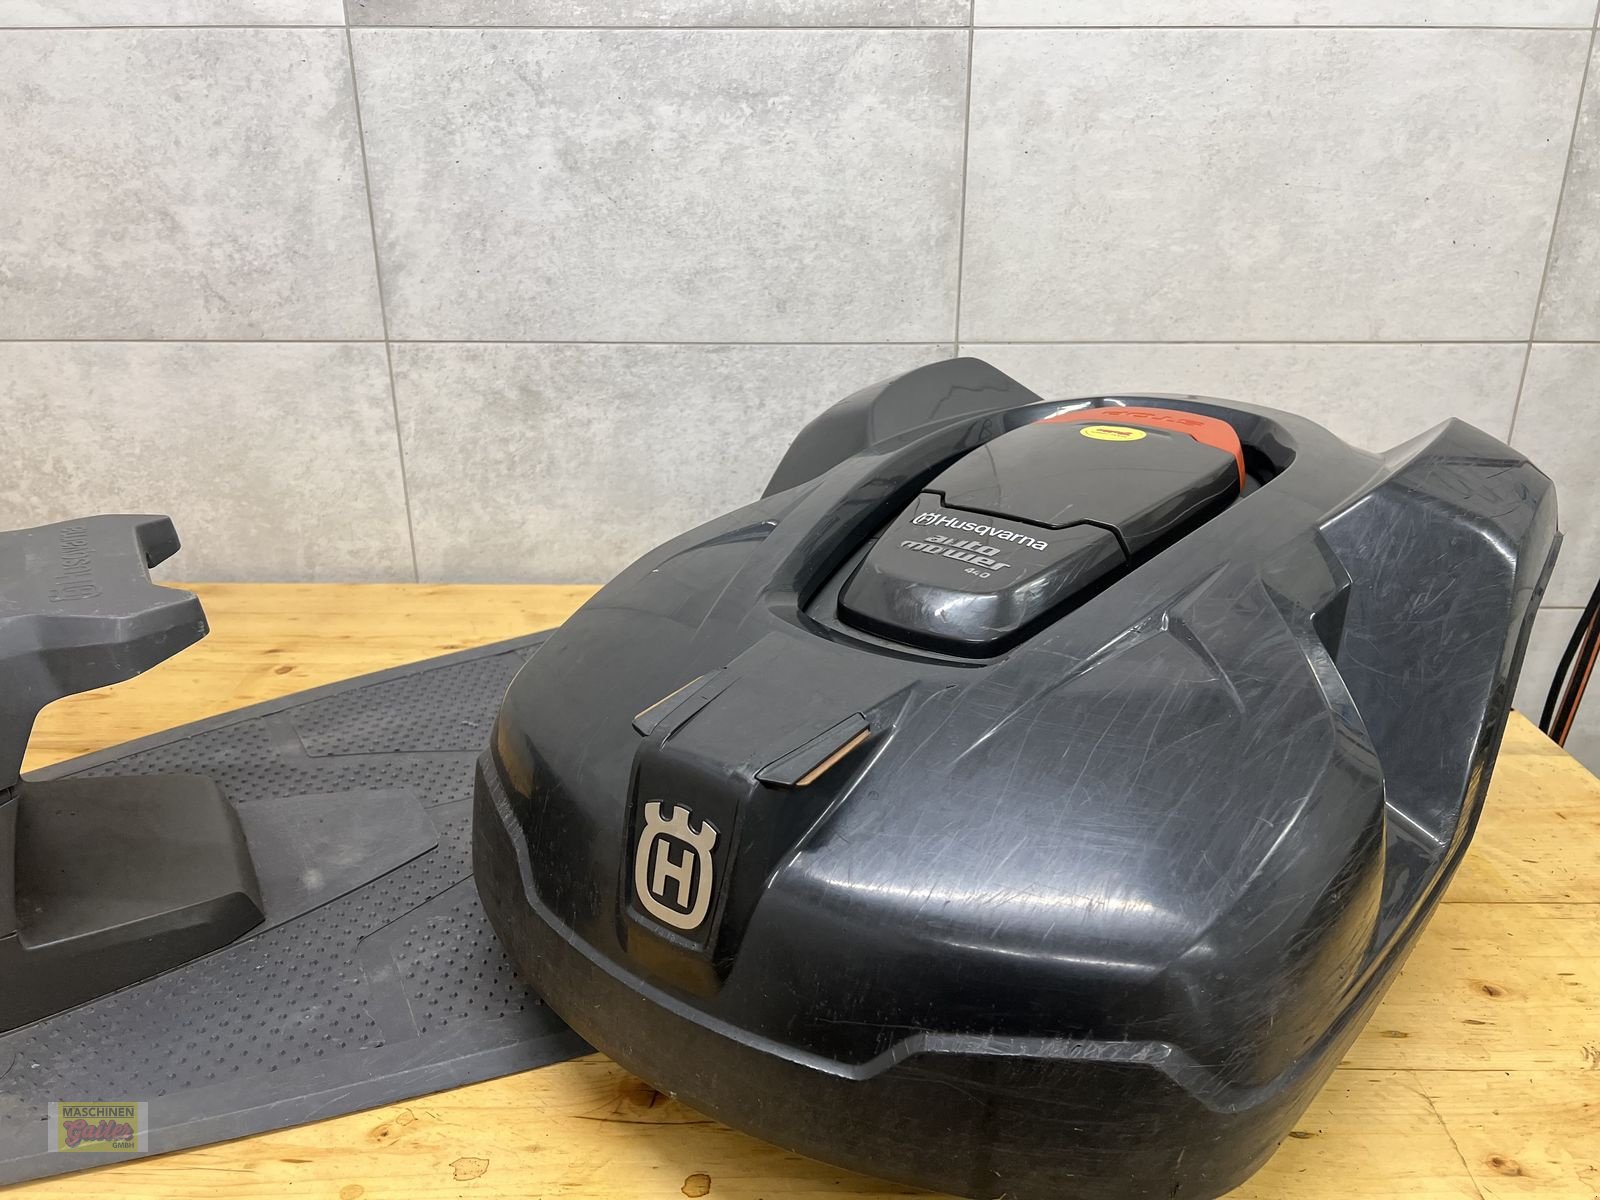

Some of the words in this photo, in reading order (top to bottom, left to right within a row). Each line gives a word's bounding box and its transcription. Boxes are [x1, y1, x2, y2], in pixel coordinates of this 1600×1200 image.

[924, 534, 1001, 557] auto
[933, 516, 1049, 552] Husqvarna
[900, 540, 1011, 571] mower
